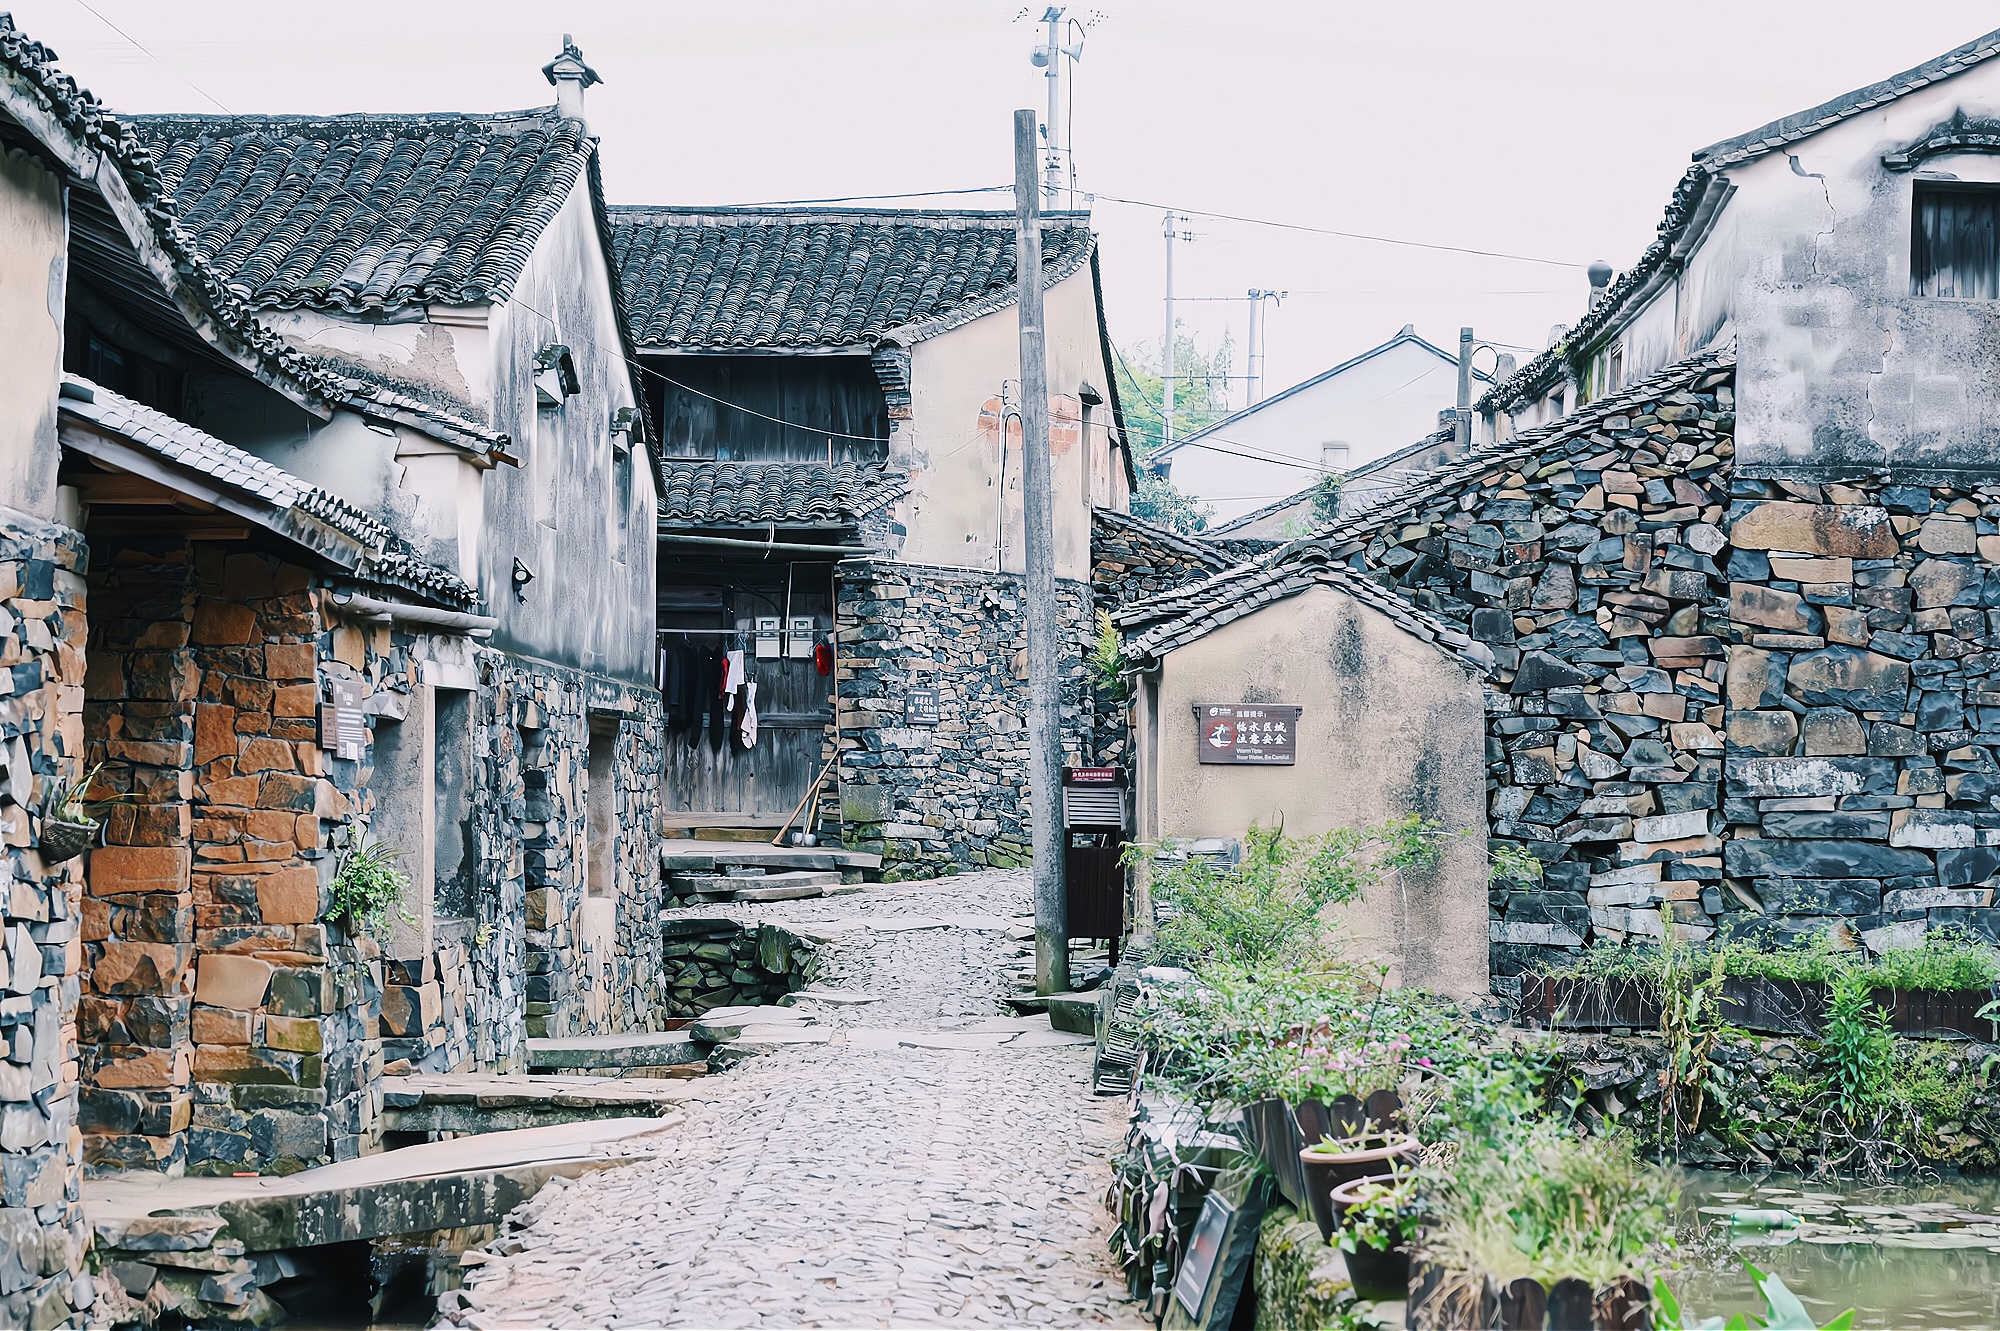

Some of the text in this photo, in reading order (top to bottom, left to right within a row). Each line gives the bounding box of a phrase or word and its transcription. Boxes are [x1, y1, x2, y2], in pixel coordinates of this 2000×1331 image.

[1236, 721, 1287, 733] 临水区域
[1236, 733, 1287, 745] 注意安全
